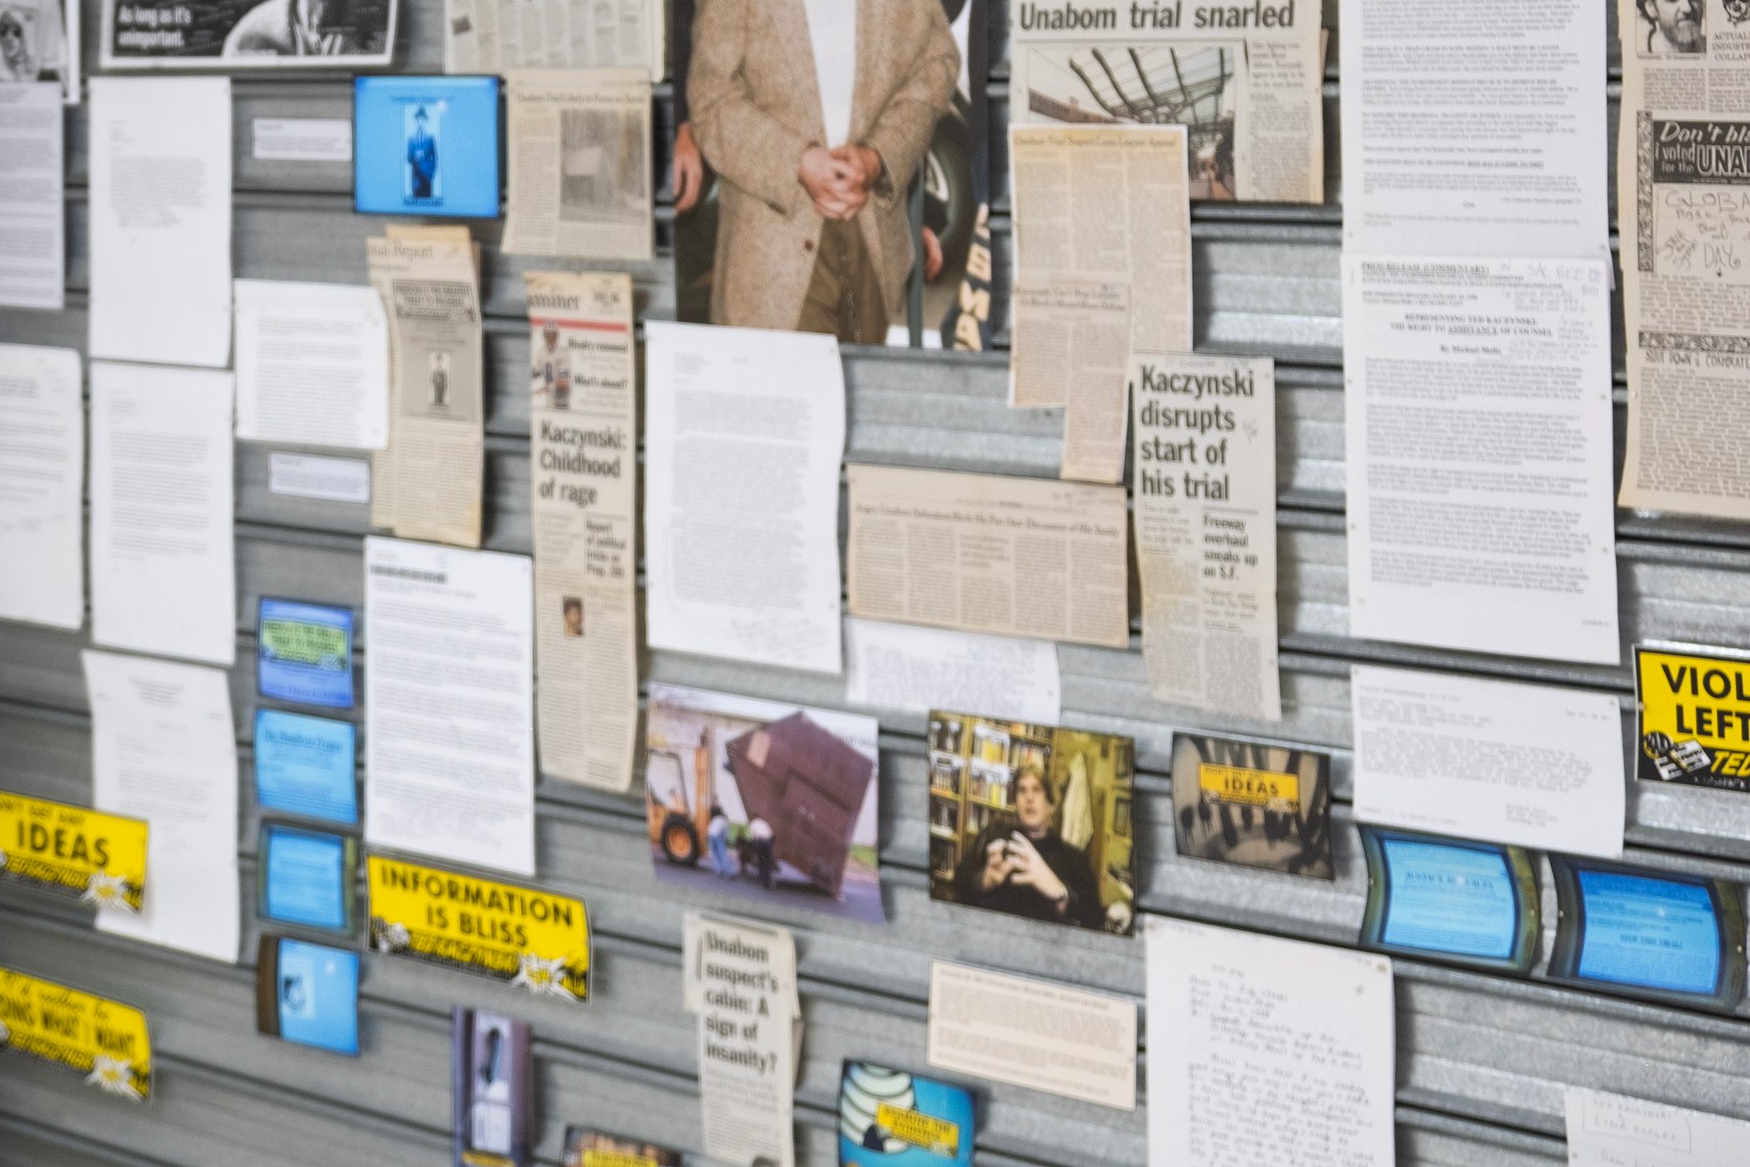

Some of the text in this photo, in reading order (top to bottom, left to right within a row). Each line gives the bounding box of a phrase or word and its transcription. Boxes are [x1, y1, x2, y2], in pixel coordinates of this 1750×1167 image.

[136, 5, 157, 26] long
[1019, 1, 1117, 31] Unabom
[1130, 0, 1181, 29] trial
[1660, 121, 1723, 143] Don't
[1662, 142, 1696, 164] voted
[1141, 365, 1255, 399] Kaczynski
[1141, 400, 1236, 433] disrupts
[540, 449, 621, 479] Childhood
[1141, 436, 1228, 464] start of
[539, 479, 599, 509] of rage
[1141, 469, 1230, 500] his trial
[1204, 514, 1246, 532] Freeway
[1205, 534, 1249, 548] overhaul
[1204, 551, 1258, 566] sneaks up
[1204, 567, 1217, 578] on
[1676, 703, 1750, 742] LEFT
[1224, 777, 1280, 796] IDEAS
[17, 820, 110, 868] IDEAS
[381, 865, 573, 928] INFORMATION
[426, 904, 528, 948] IS BLISS
[706, 931, 770, 962] Unabom
[706, 963, 779, 994] suspect's
[758, 997, 770, 1018] A
[706, 1012, 759, 1041] sign of
[706, 1040, 778, 1075] insanity?
